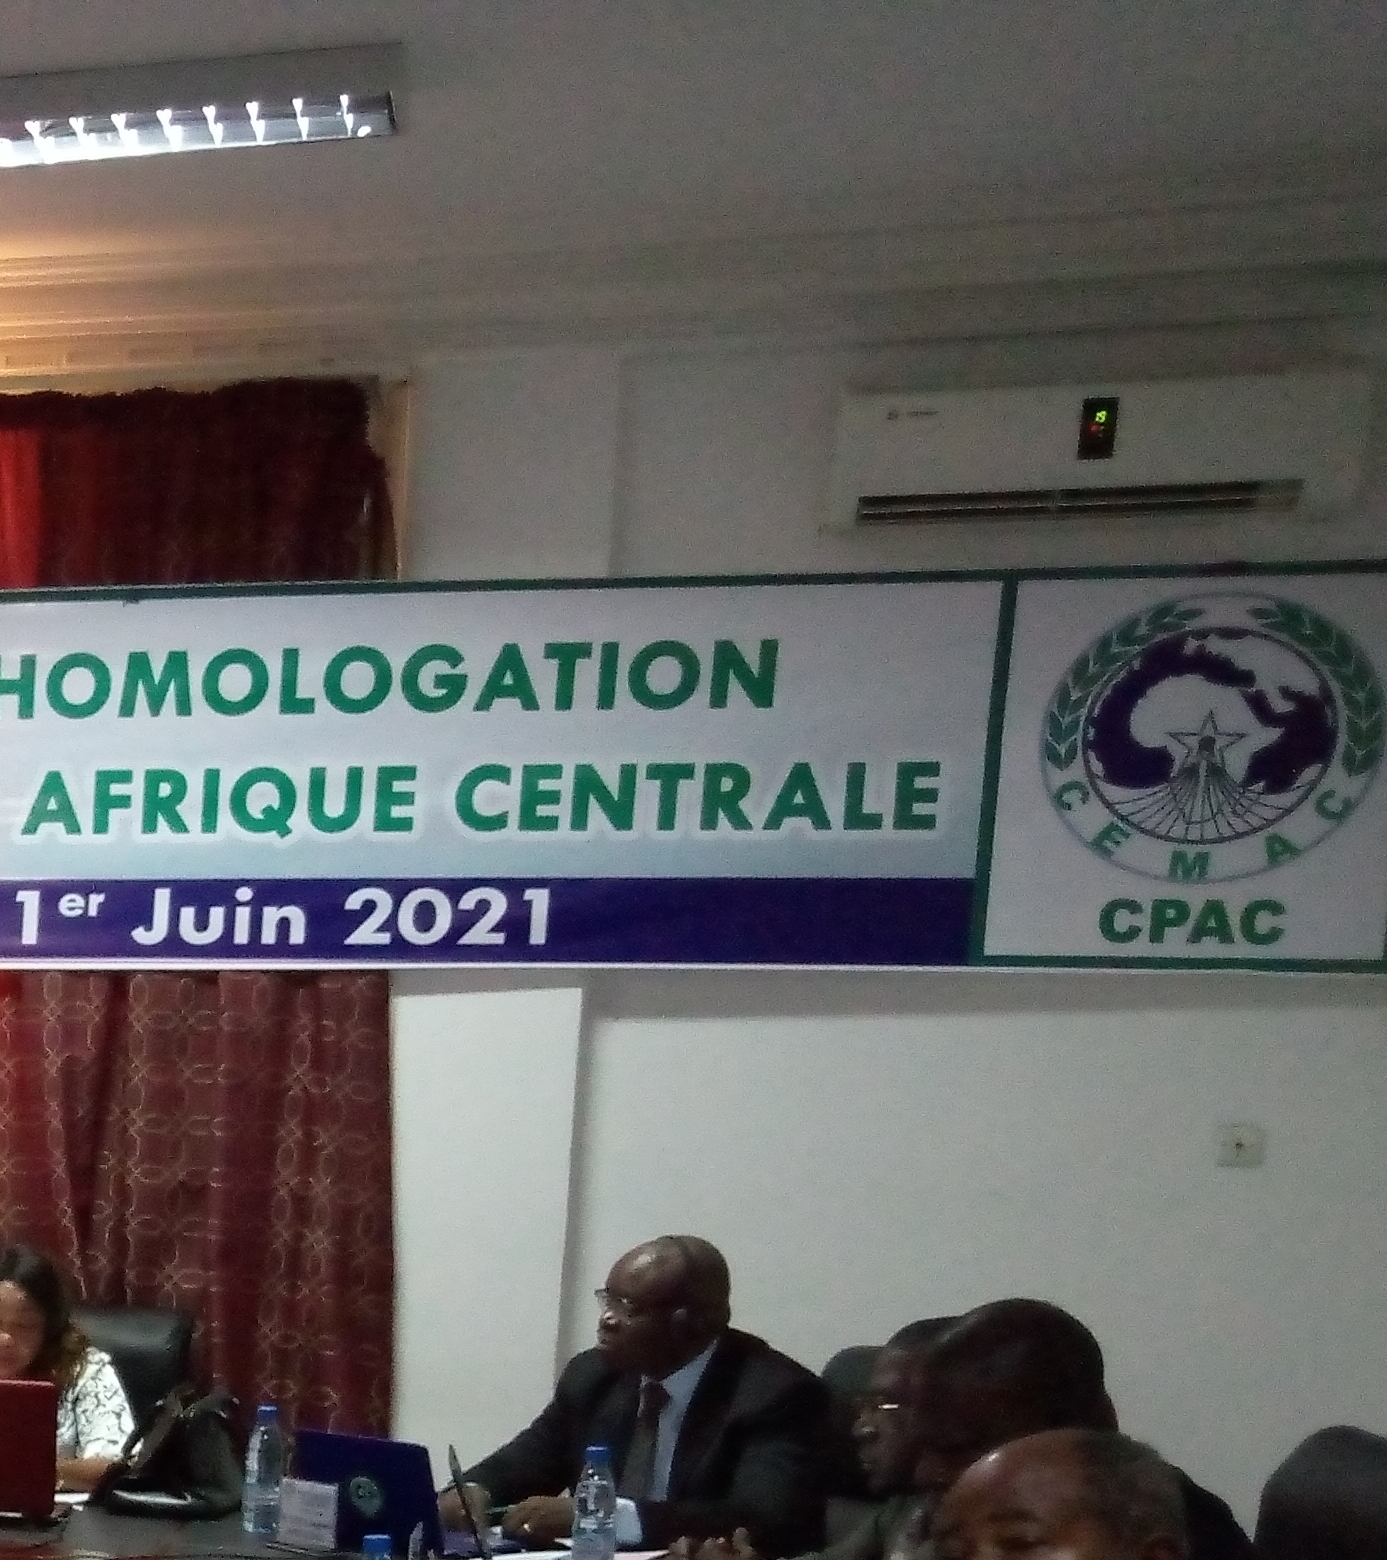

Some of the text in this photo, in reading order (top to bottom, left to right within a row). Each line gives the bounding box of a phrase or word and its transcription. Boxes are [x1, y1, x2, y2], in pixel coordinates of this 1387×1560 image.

[20, 764, 418, 839] AFRIQUE
[454, 761, 942, 833] CENTRALE
[1052, 780, 1352, 881] CEMAC
[130, 887, 307, 947] Juin
[343, 886, 551, 947] 2021
[1098, 898, 1287, 945] CPAC
